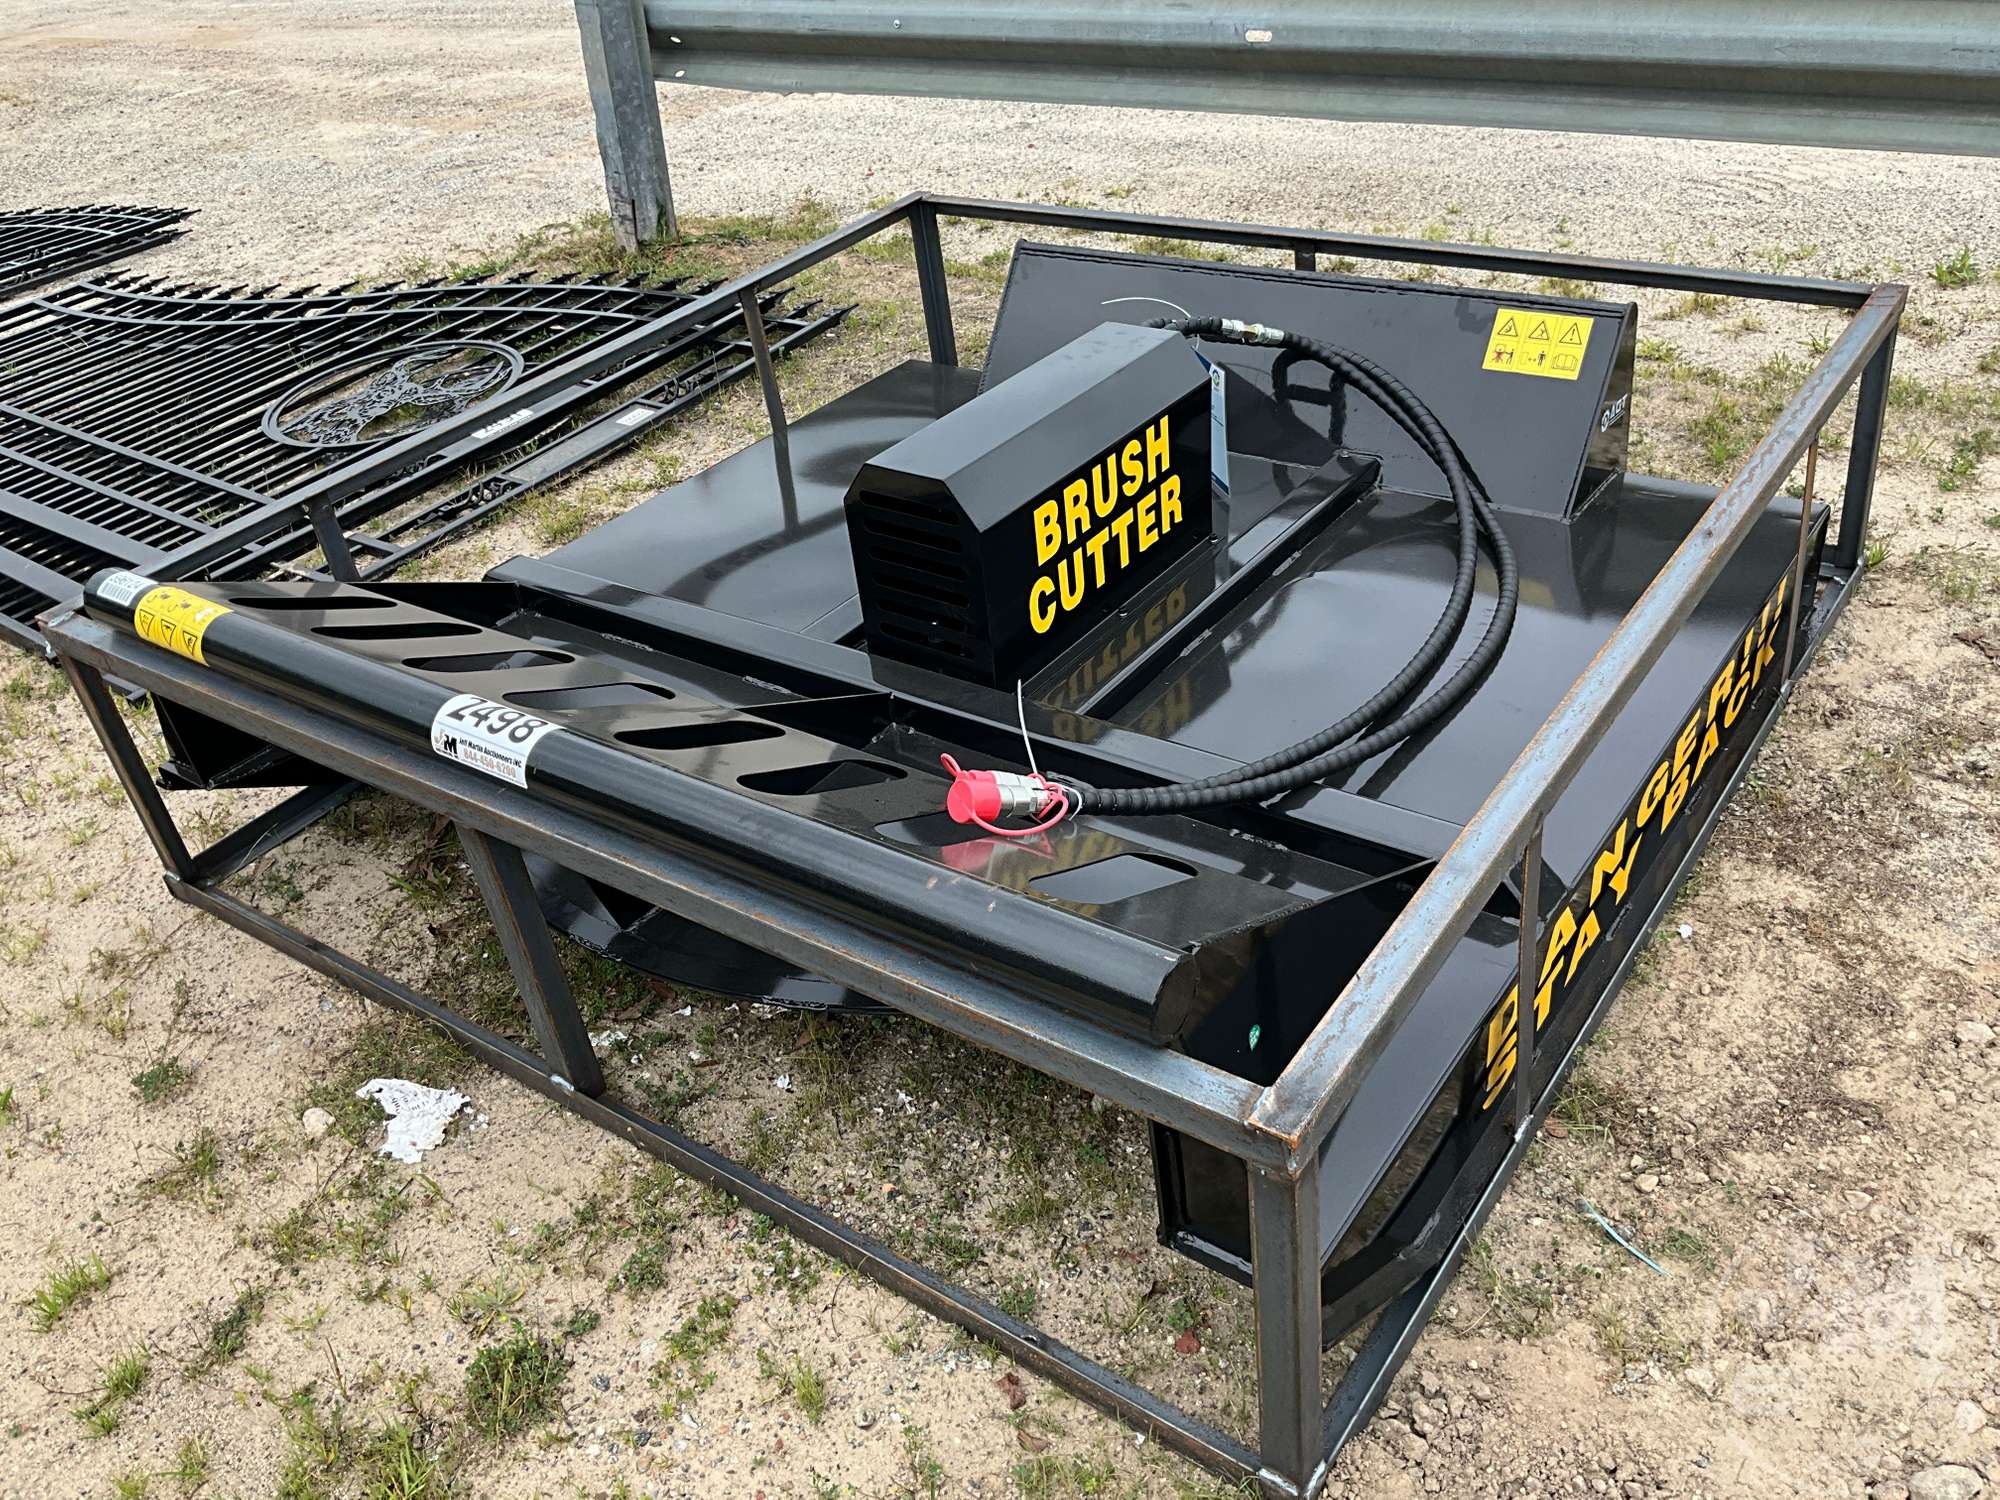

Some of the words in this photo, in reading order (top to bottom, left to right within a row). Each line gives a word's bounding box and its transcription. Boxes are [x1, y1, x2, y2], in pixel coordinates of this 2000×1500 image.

[1029, 475, 1184, 635] CUTTER
[1033, 415, 1170, 568] BRUSH
[446, 696, 548, 743] 2498
[468, 740, 483, 752] Martin
[1482, 833, 1642, 1110] STAY
[1661, 619, 1776, 835] BACK
